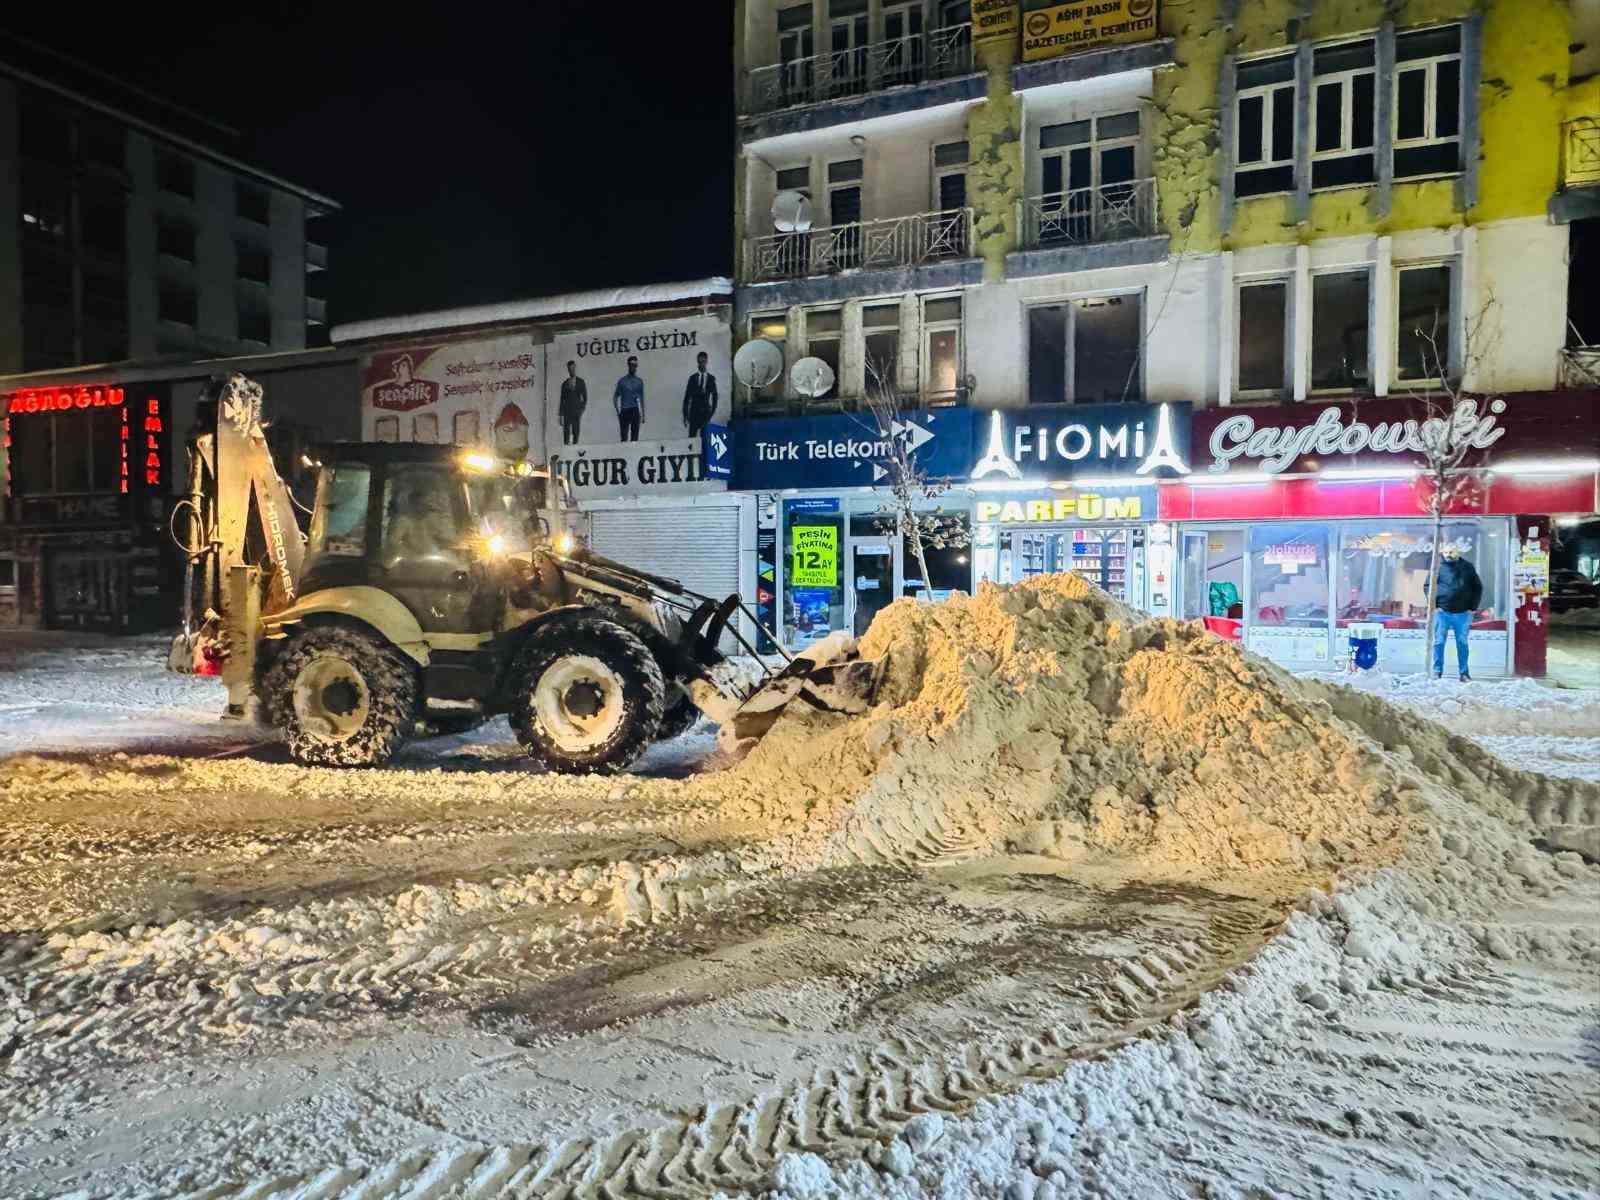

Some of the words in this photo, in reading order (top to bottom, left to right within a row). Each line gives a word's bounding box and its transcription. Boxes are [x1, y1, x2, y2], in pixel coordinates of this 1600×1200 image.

[1025, 27, 1098, 50] GAZETECİLER
[576, 337, 631, 359] UĞUR
[636, 330, 699, 352] GİYİM
[9, 388, 125, 414] AĞAOĞLU
[145, 399, 162, 485] EMLAK
[756, 442, 800, 461] Türk
[805, 438, 894, 460] Telekom
[637, 443, 710, 484] GİYİ
[977, 494, 1142, 523] PARFÜM
[795, 551, 821, 569] 12
[822, 559, 833, 569] AY
